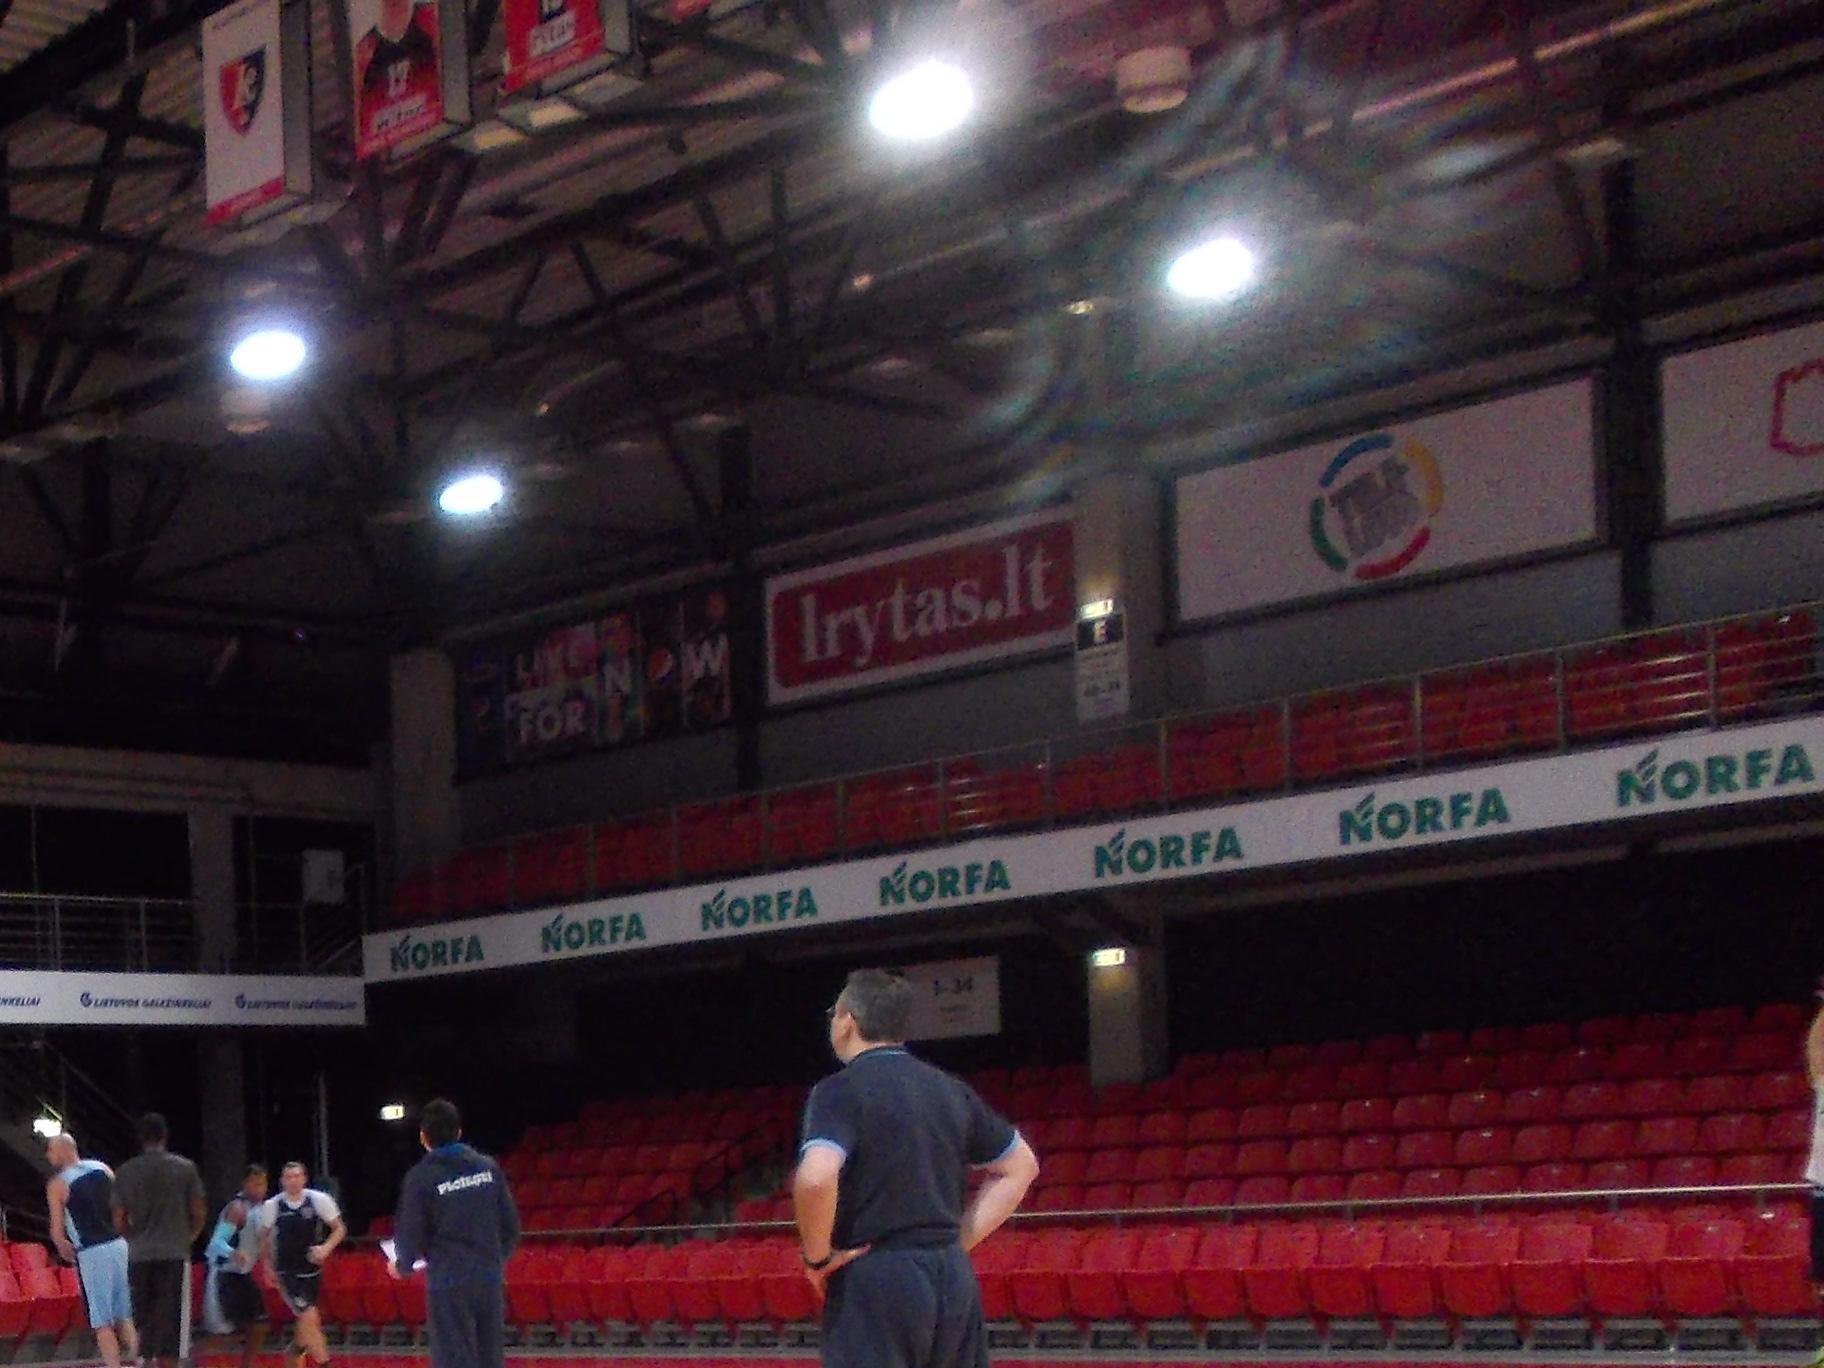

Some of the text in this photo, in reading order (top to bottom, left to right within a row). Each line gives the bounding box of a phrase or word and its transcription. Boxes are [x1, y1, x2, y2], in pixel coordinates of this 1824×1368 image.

[801, 541, 1055, 665] lrytas.lt
[519, 698, 588, 745] FOR
[1616, 742, 1816, 806] NORFA
[1339, 788, 1511, 847] NORFA
[1093, 825, 1244, 879] NORFA
[879, 859, 1013, 907] NORFA
[541, 911, 647, 954] NORFA
[701, 885, 819, 933] NORFA
[389, 934, 485, 973] NORFA
